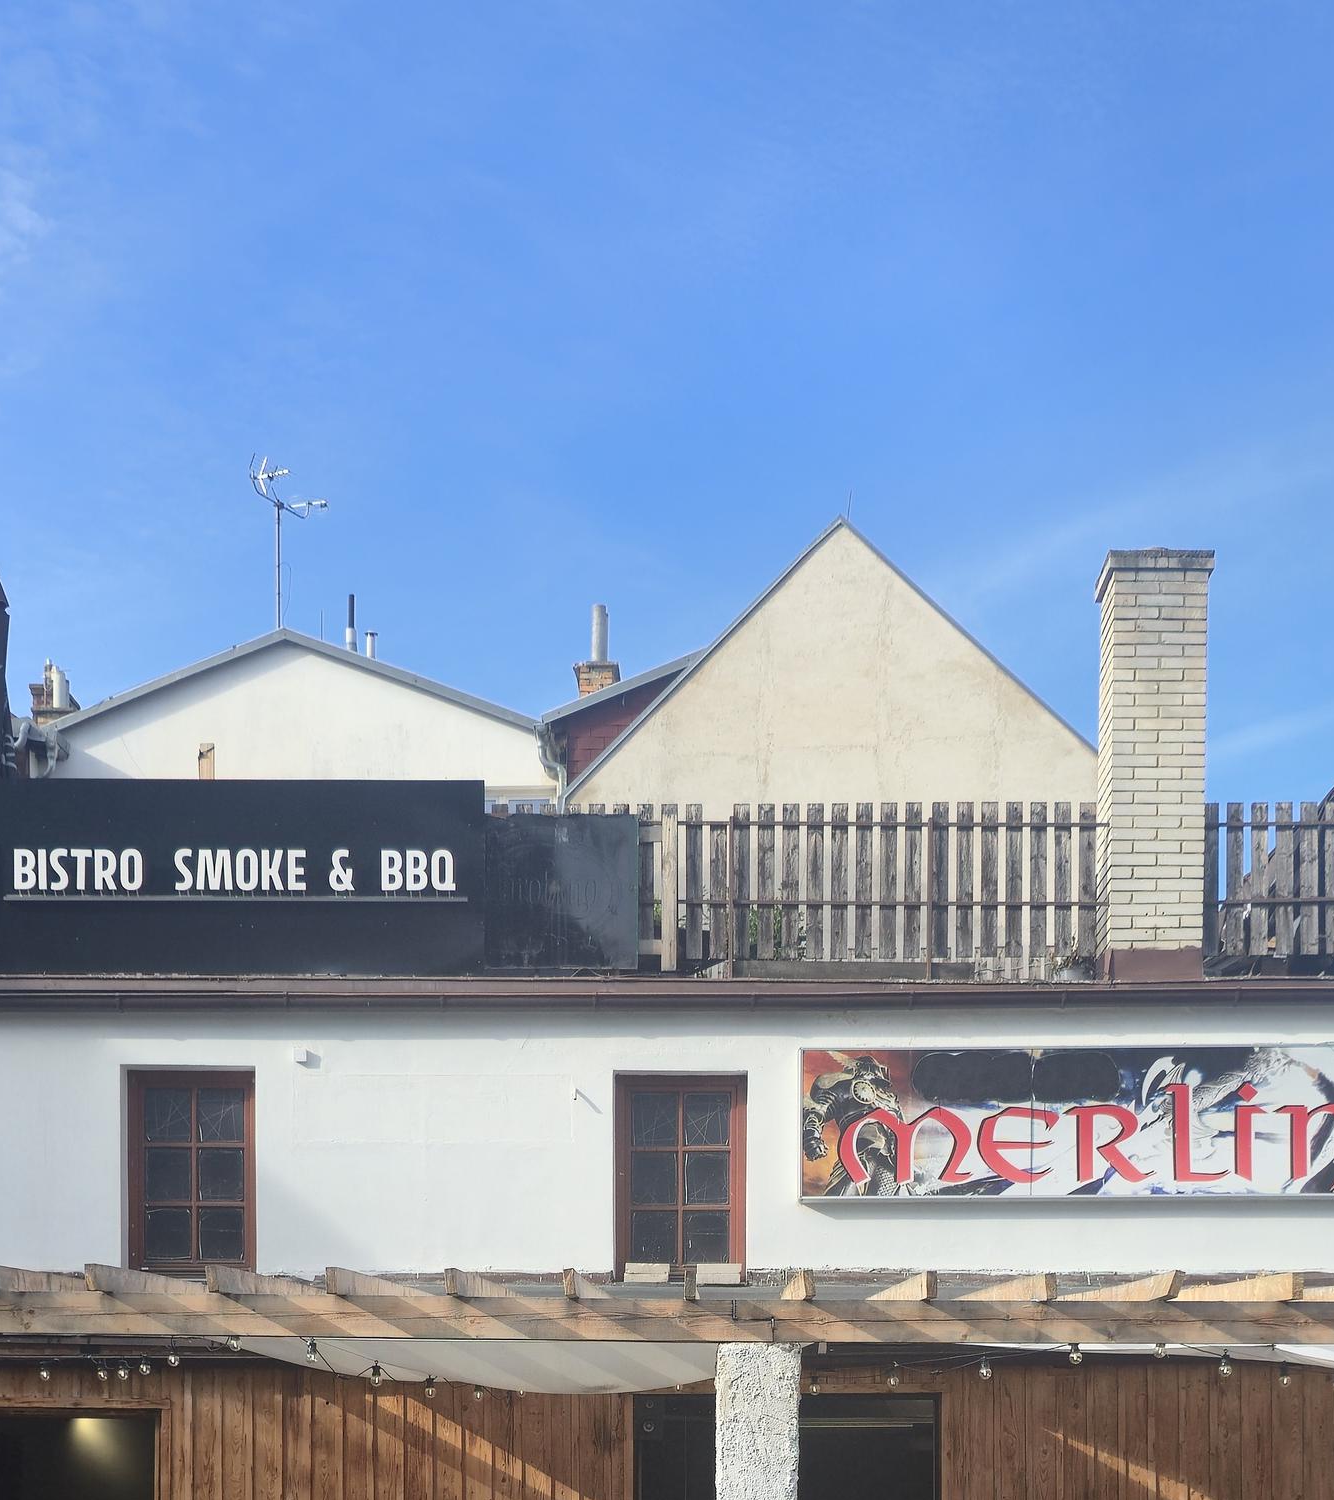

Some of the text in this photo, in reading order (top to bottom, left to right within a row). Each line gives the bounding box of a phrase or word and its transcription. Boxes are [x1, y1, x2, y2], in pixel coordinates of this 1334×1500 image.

[13, 848, 143, 891] BISTRO
[174, 848, 307, 891] SMOKE
[328, 849, 355, 892] &
[381, 849, 456, 891] BBQ
